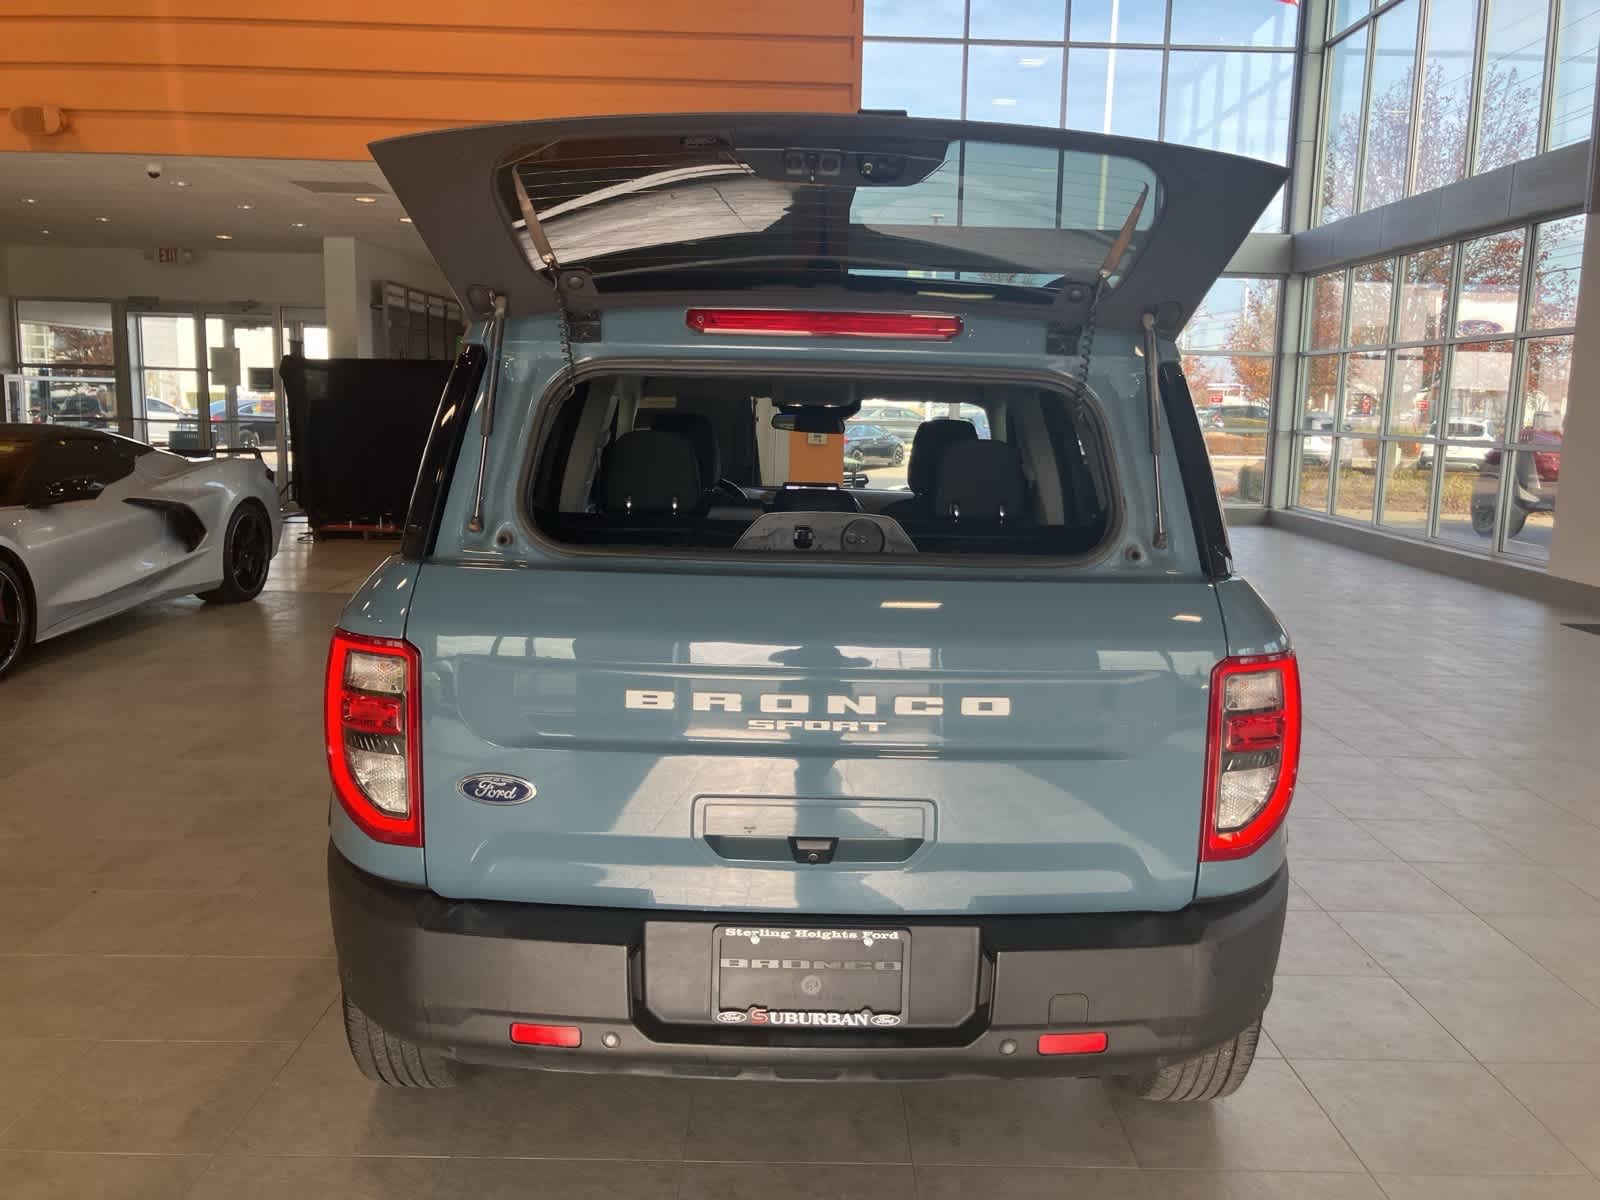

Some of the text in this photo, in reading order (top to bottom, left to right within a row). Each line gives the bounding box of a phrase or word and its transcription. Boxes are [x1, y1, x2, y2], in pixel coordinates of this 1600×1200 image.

[625, 689, 1012, 717] BRONCO
[747, 719, 887, 732] SPORT
[474, 780, 517, 799] Ford
[725, 928, 899, 940] Sterling Heights Ford
[720, 958, 902, 970] BRONCO
[751, 1008, 868, 1026] SUBURBAN
